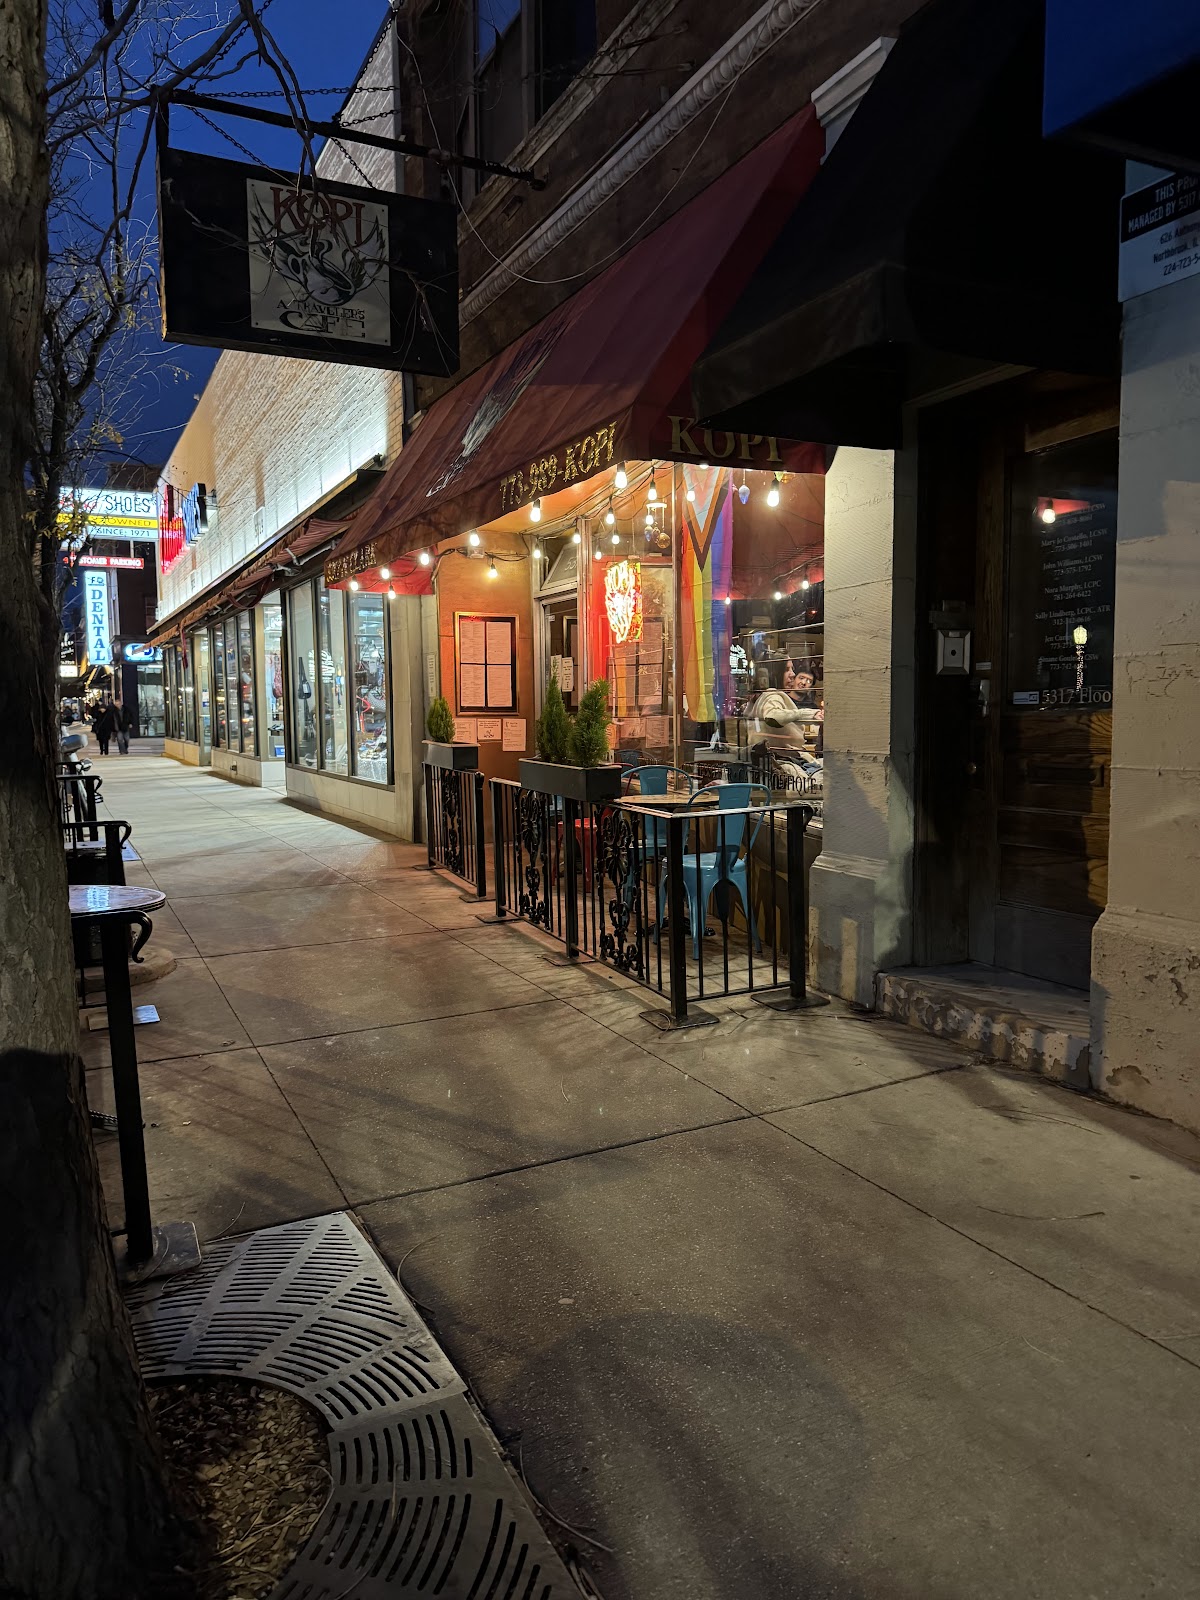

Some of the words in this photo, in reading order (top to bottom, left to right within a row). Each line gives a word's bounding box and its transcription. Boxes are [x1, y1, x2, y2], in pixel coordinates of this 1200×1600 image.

[1155, 183, 1174, 203] THIS
[268, 186, 366, 248] KOPI
[1127, 206, 1163, 233] MANAGED
[1165, 200, 1175, 216] BY
[276, 299, 288, 310] A
[667, 415, 782, 462] KOPI
[499, 421, 617, 511] 773-989-KOPI
[105, 494, 151, 513] SHOES
[107, 517, 151, 527] OWNED
[131, 529, 150, 537] 1971
[1084, 554, 1104, 563] LCSW
[1084, 580, 1101, 589] LCPC
[91, 589, 106, 662] DENTAL
[1042, 689, 1075, 704] 5317
